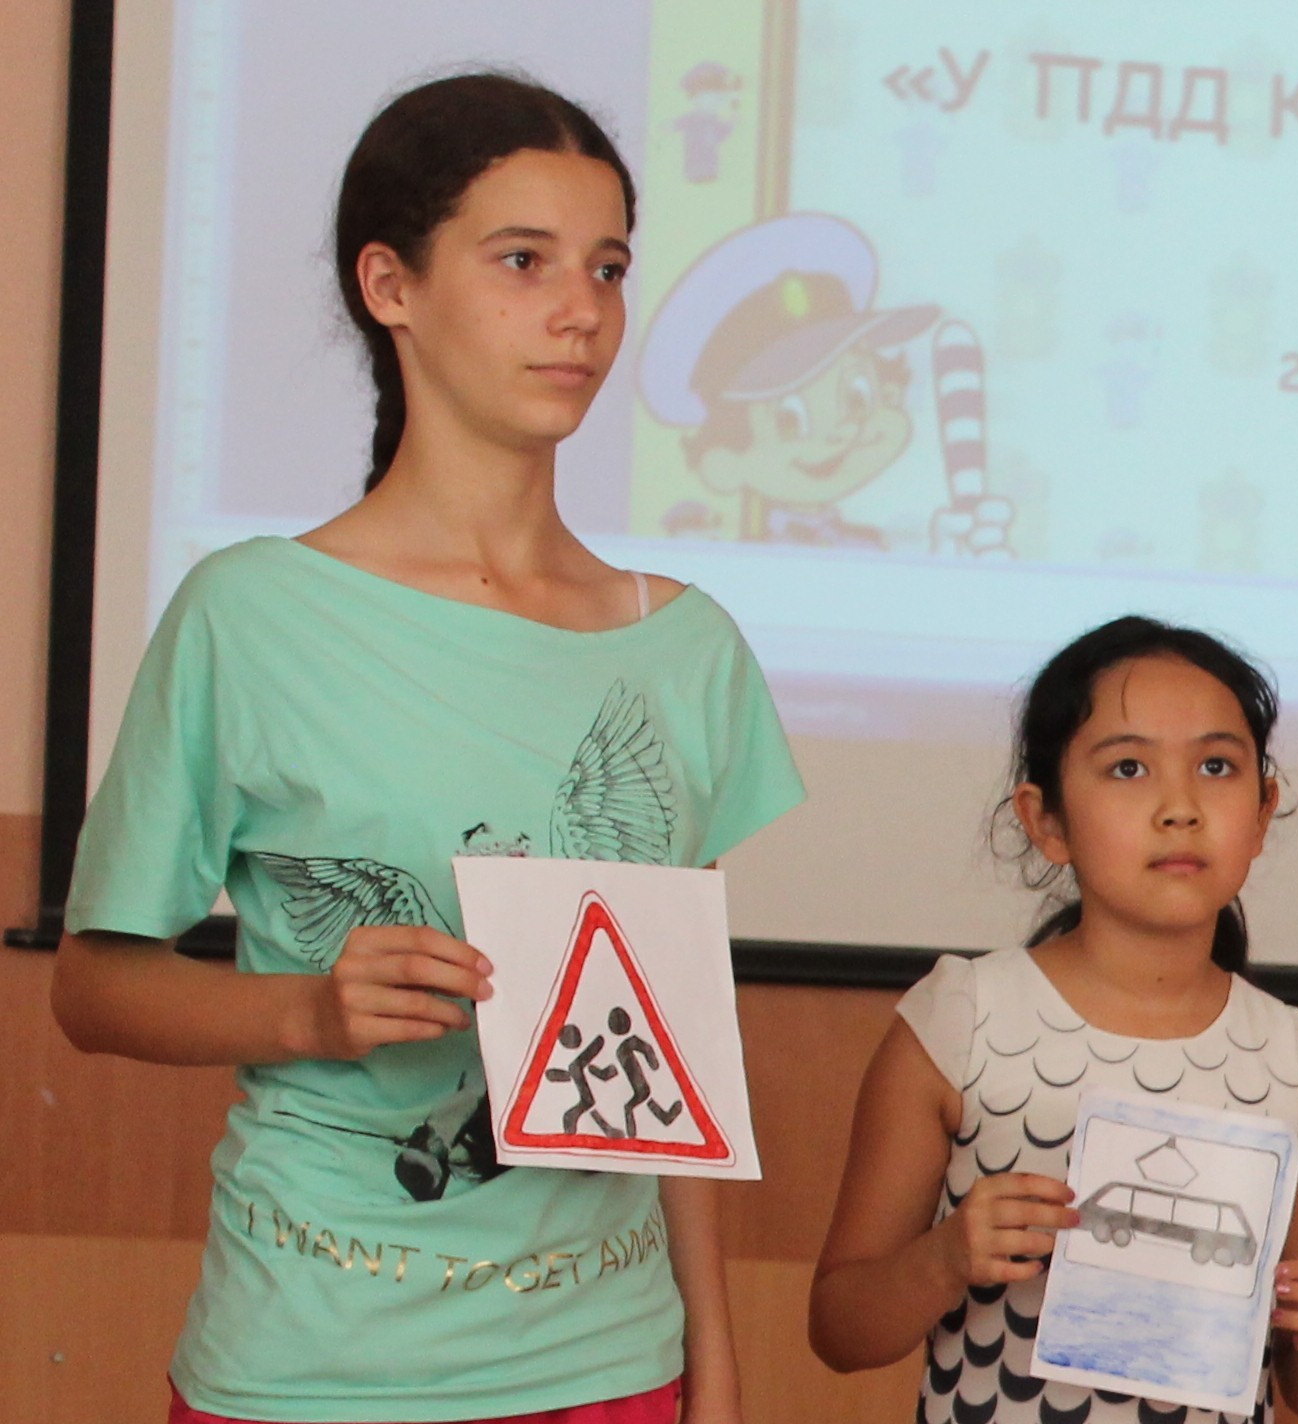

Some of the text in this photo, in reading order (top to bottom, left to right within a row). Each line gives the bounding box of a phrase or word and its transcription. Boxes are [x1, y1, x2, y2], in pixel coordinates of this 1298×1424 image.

[883, 47, 990, 114] «У
[1029, 52, 1231, 145] ПДД
[245, 1202, 256, 1238] I
[271, 1210, 422, 1283] WANT
